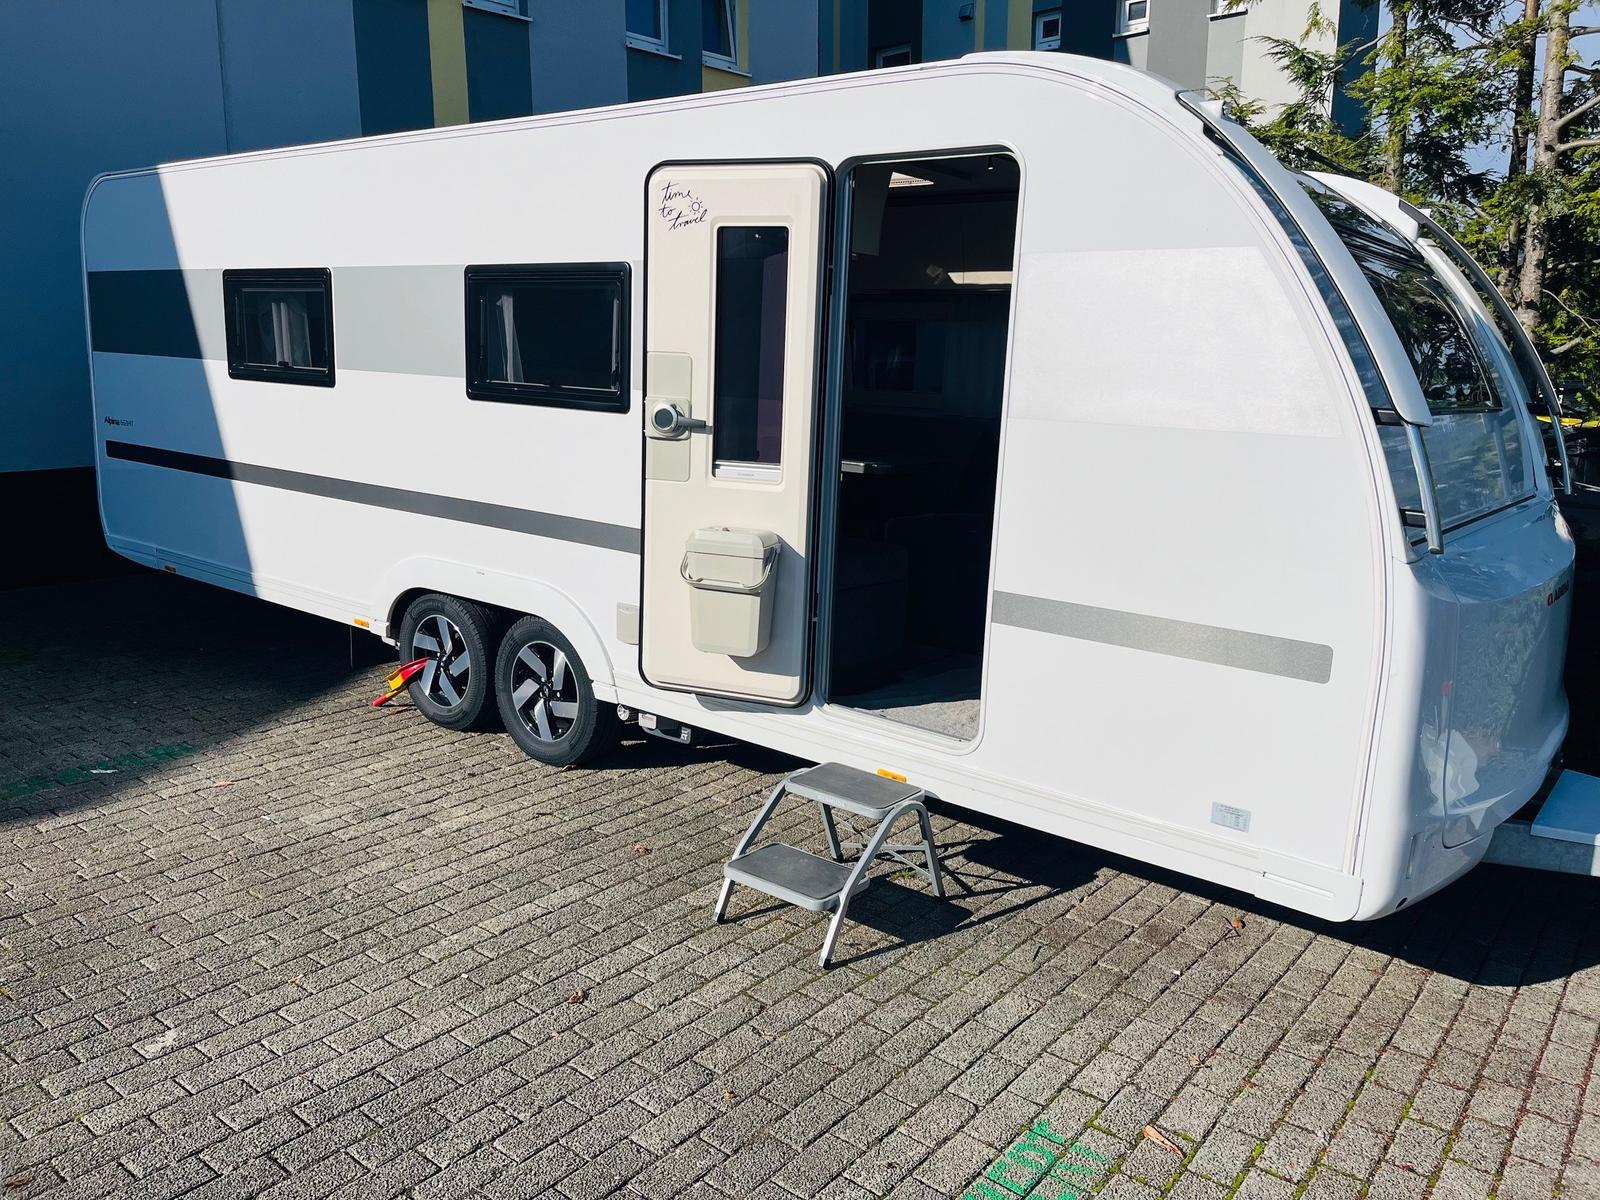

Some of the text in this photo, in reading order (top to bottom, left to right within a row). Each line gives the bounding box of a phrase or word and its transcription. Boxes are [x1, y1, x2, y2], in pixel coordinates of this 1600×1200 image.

[661, 181, 692, 204] time
[658, 203, 676, 218] to
[668, 209, 707, 231] travel
